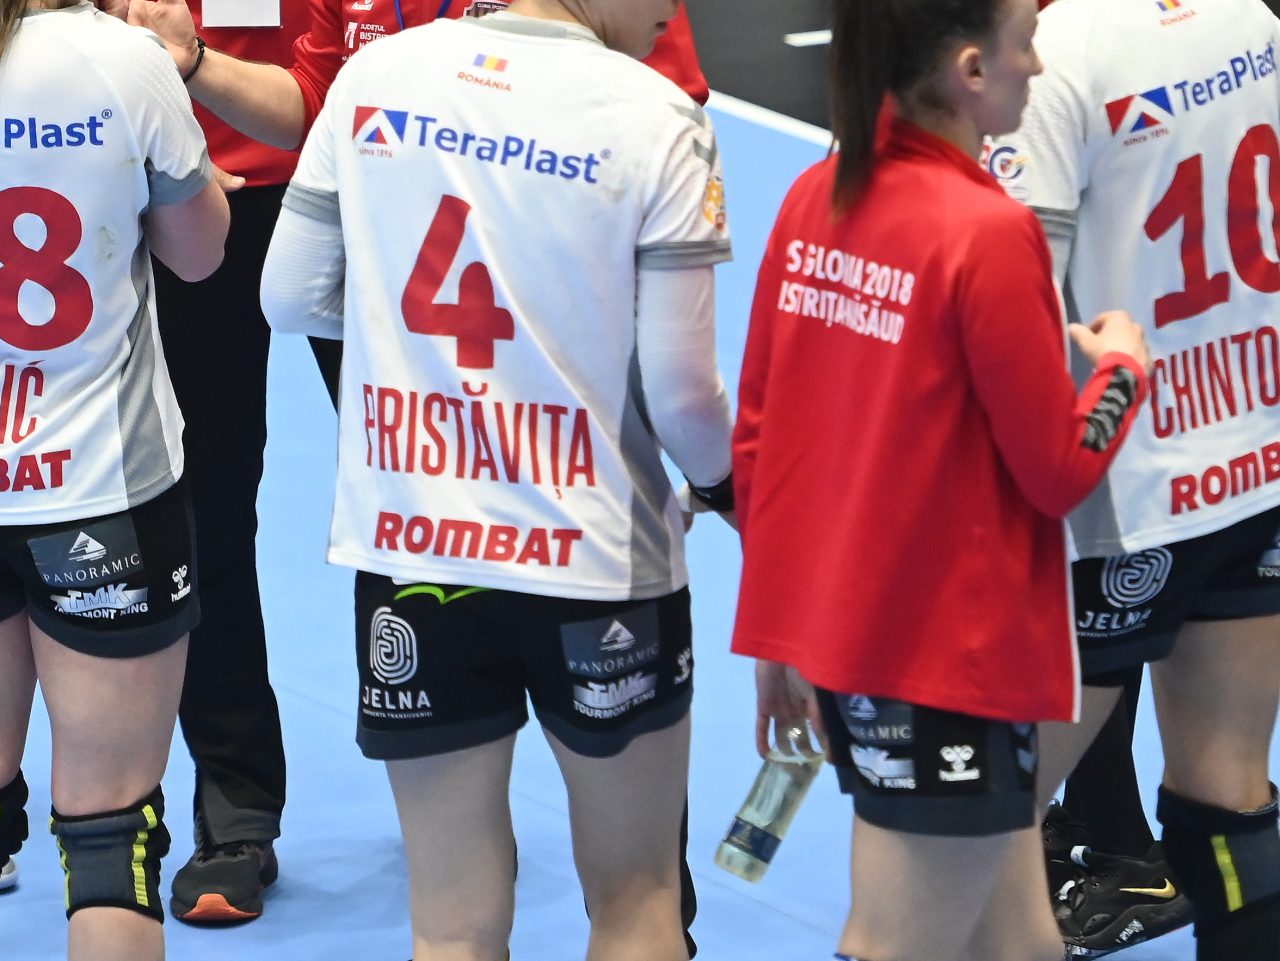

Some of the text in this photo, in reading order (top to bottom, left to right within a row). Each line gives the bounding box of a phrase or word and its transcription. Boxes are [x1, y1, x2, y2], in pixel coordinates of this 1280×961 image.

[358, 146, 375, 157] since
[1143, 123, 1280, 329] 10
[401, 193, 515, 370] 4
[862, 261, 915, 306] 2018
[362, 381, 597, 500] PRISTĂVIȚA
[374, 511, 583, 568] ROMBAT
[42, 553, 141, 585] PANORAMIC
[67, 582, 132, 609] TMK
[568, 642, 659, 673] PANORAMIC
[362, 685, 432, 710] JELNA
[573, 688, 656, 719] TOURMONT KING
[883, 777, 917, 790] KING
